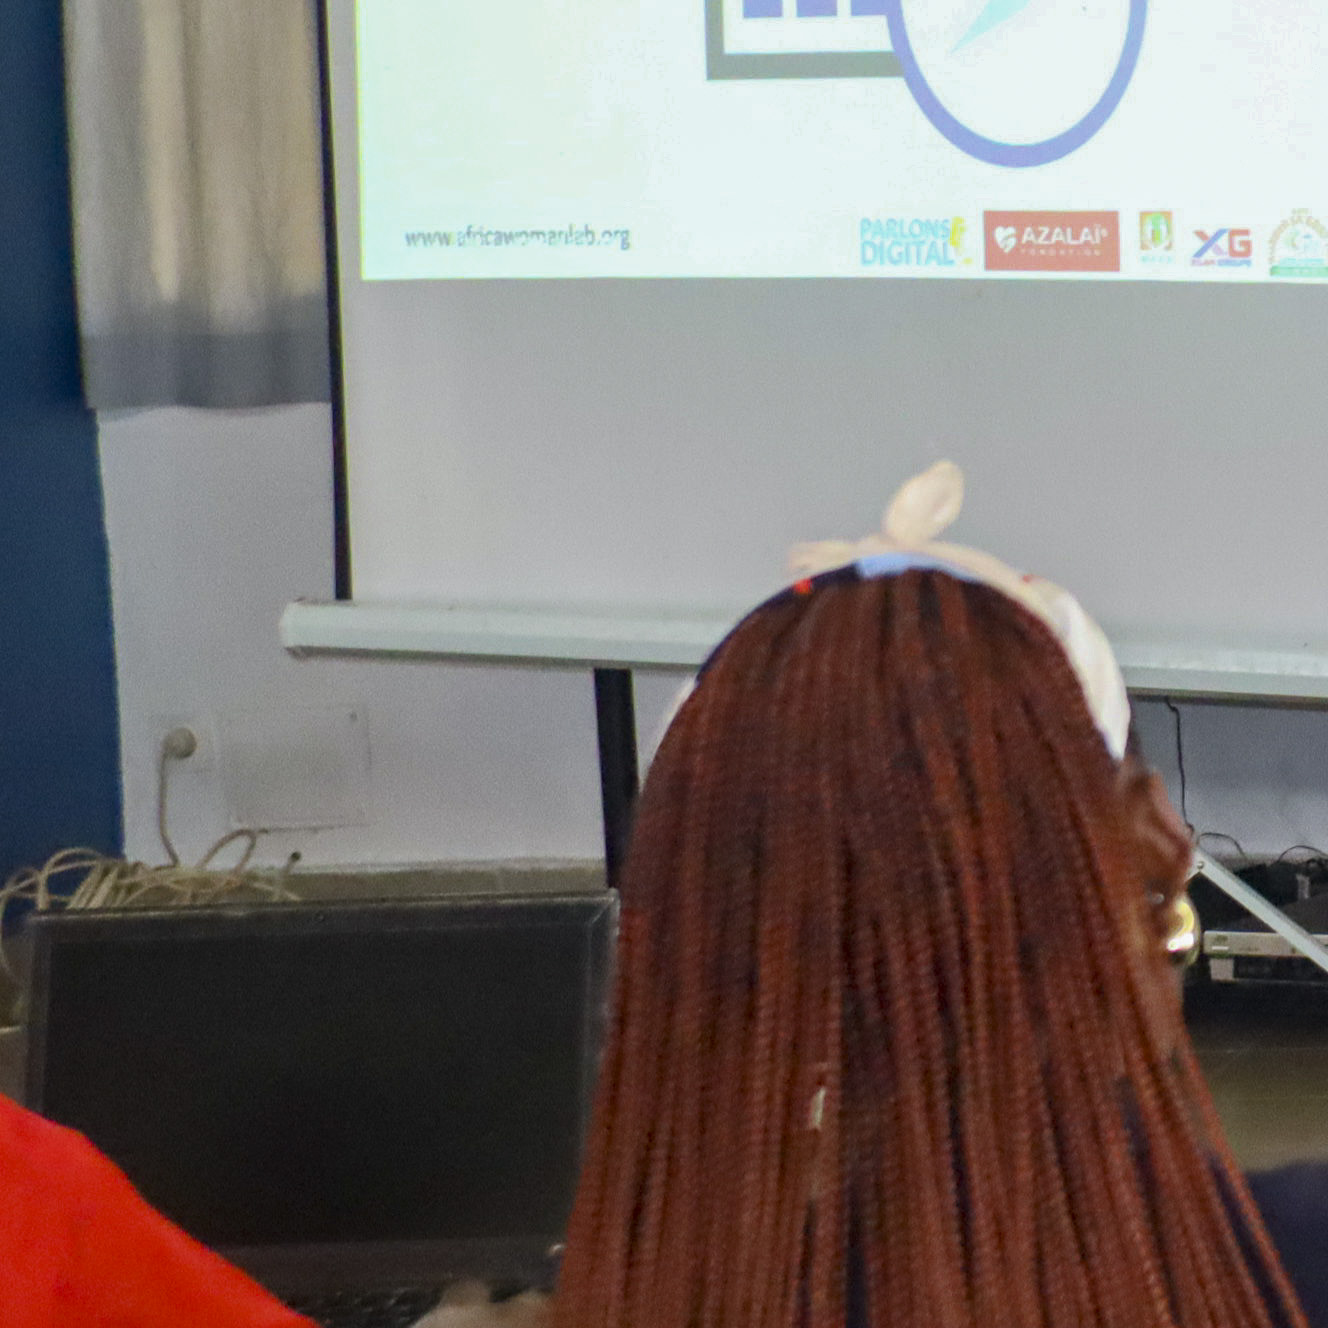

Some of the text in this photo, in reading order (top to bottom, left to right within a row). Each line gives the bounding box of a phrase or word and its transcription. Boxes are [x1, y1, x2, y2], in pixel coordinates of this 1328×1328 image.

[860, 218, 951, 240] PARLONS
[860, 240, 955, 266] DIGITAL
[1192, 228, 1252, 258] XG
